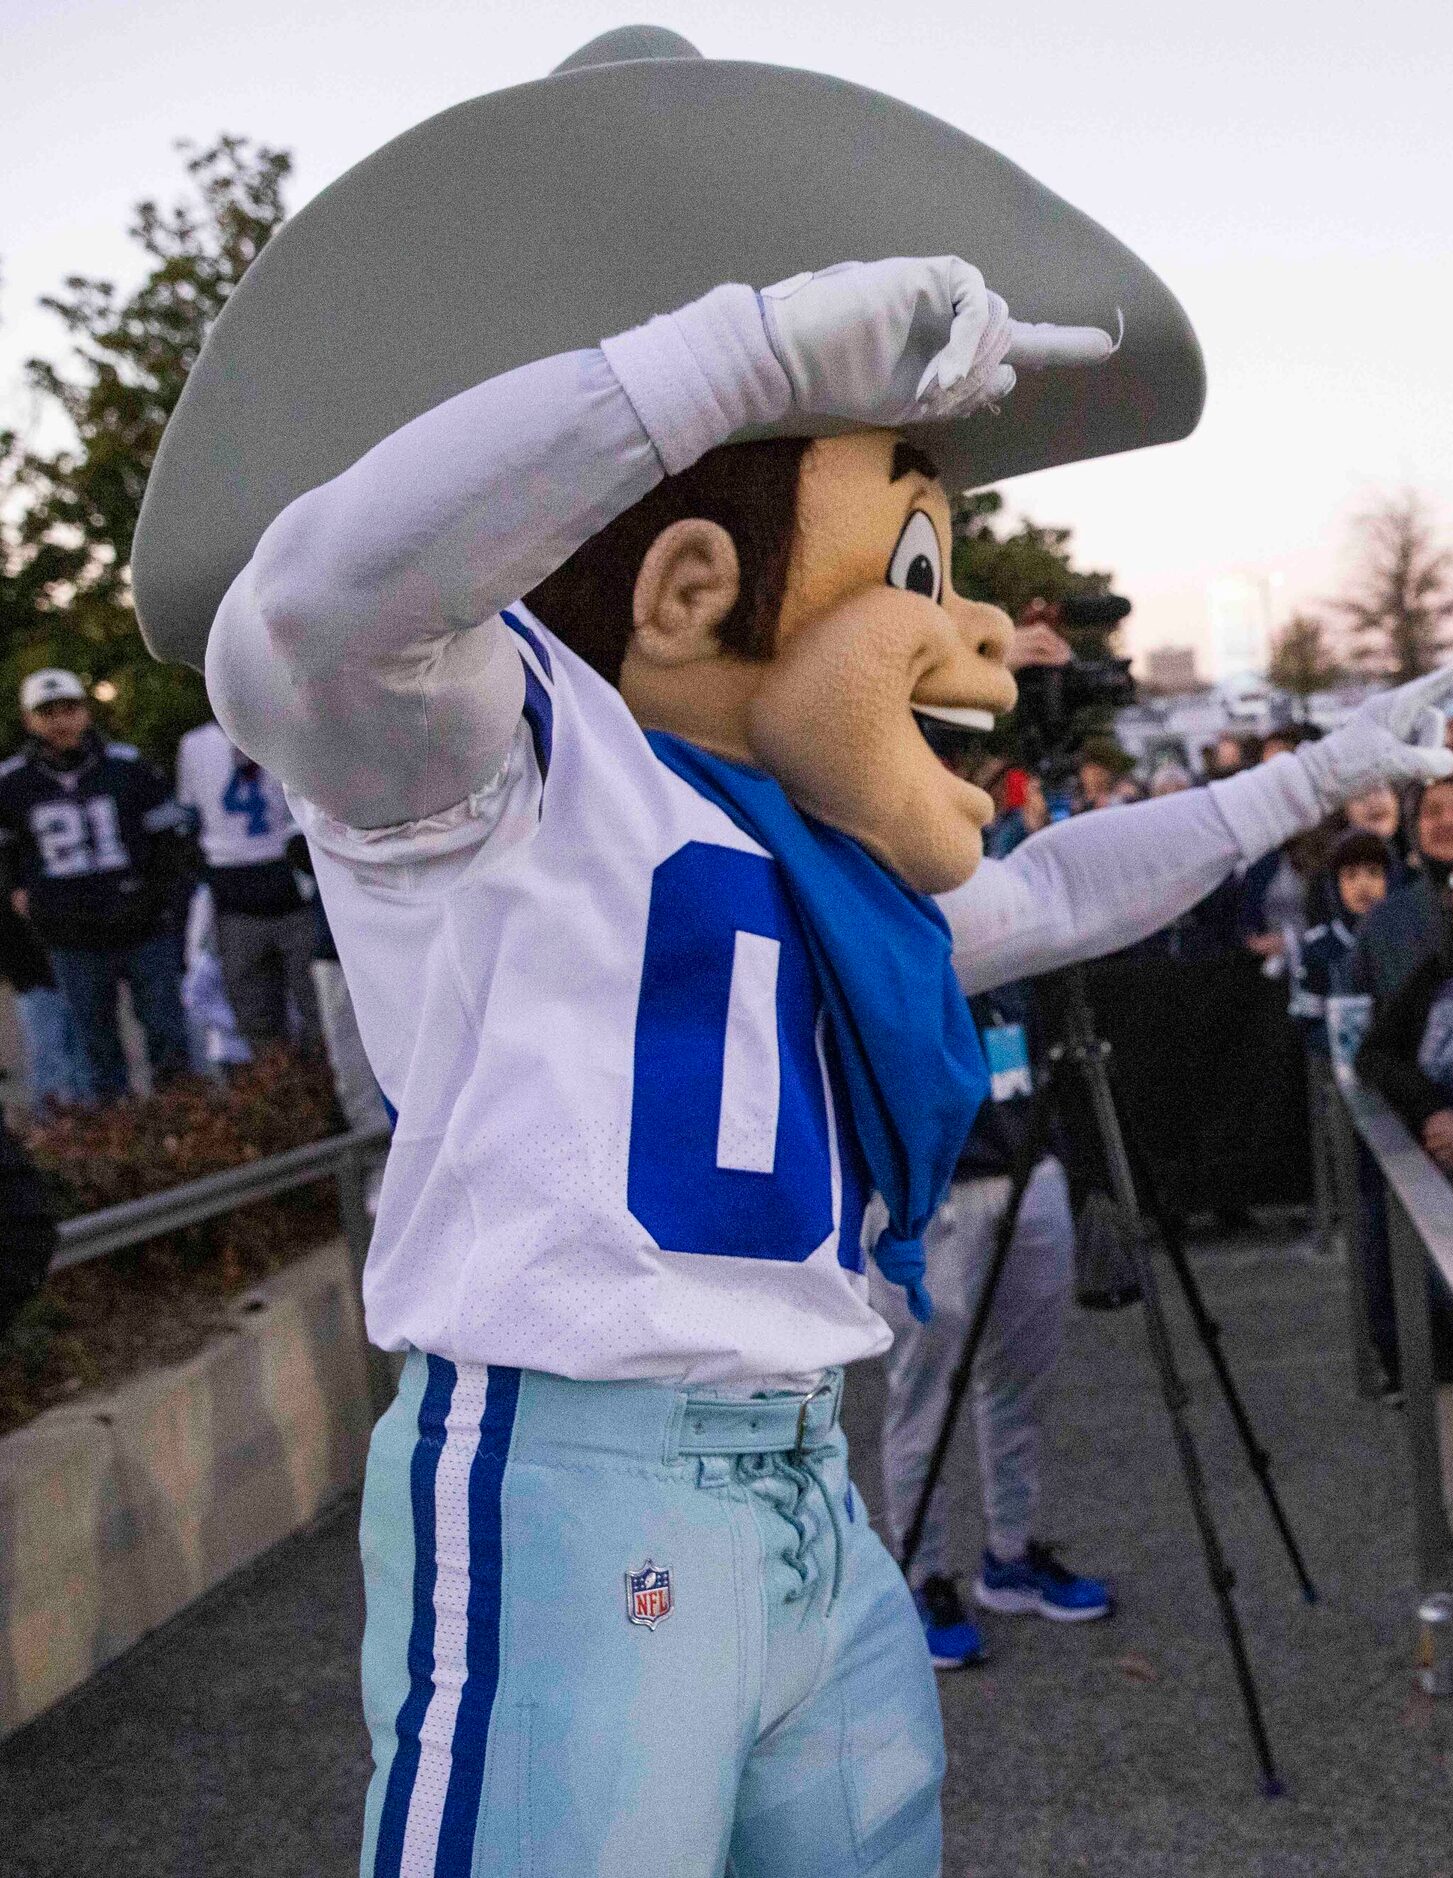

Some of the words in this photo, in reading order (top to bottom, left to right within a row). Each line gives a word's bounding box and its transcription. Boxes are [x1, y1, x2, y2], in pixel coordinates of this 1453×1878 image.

[30, 793, 131, 879] 21
[220, 762, 269, 838] 4
[627, 840, 868, 1275] 0
[636, 1589, 668, 1617] NFL
